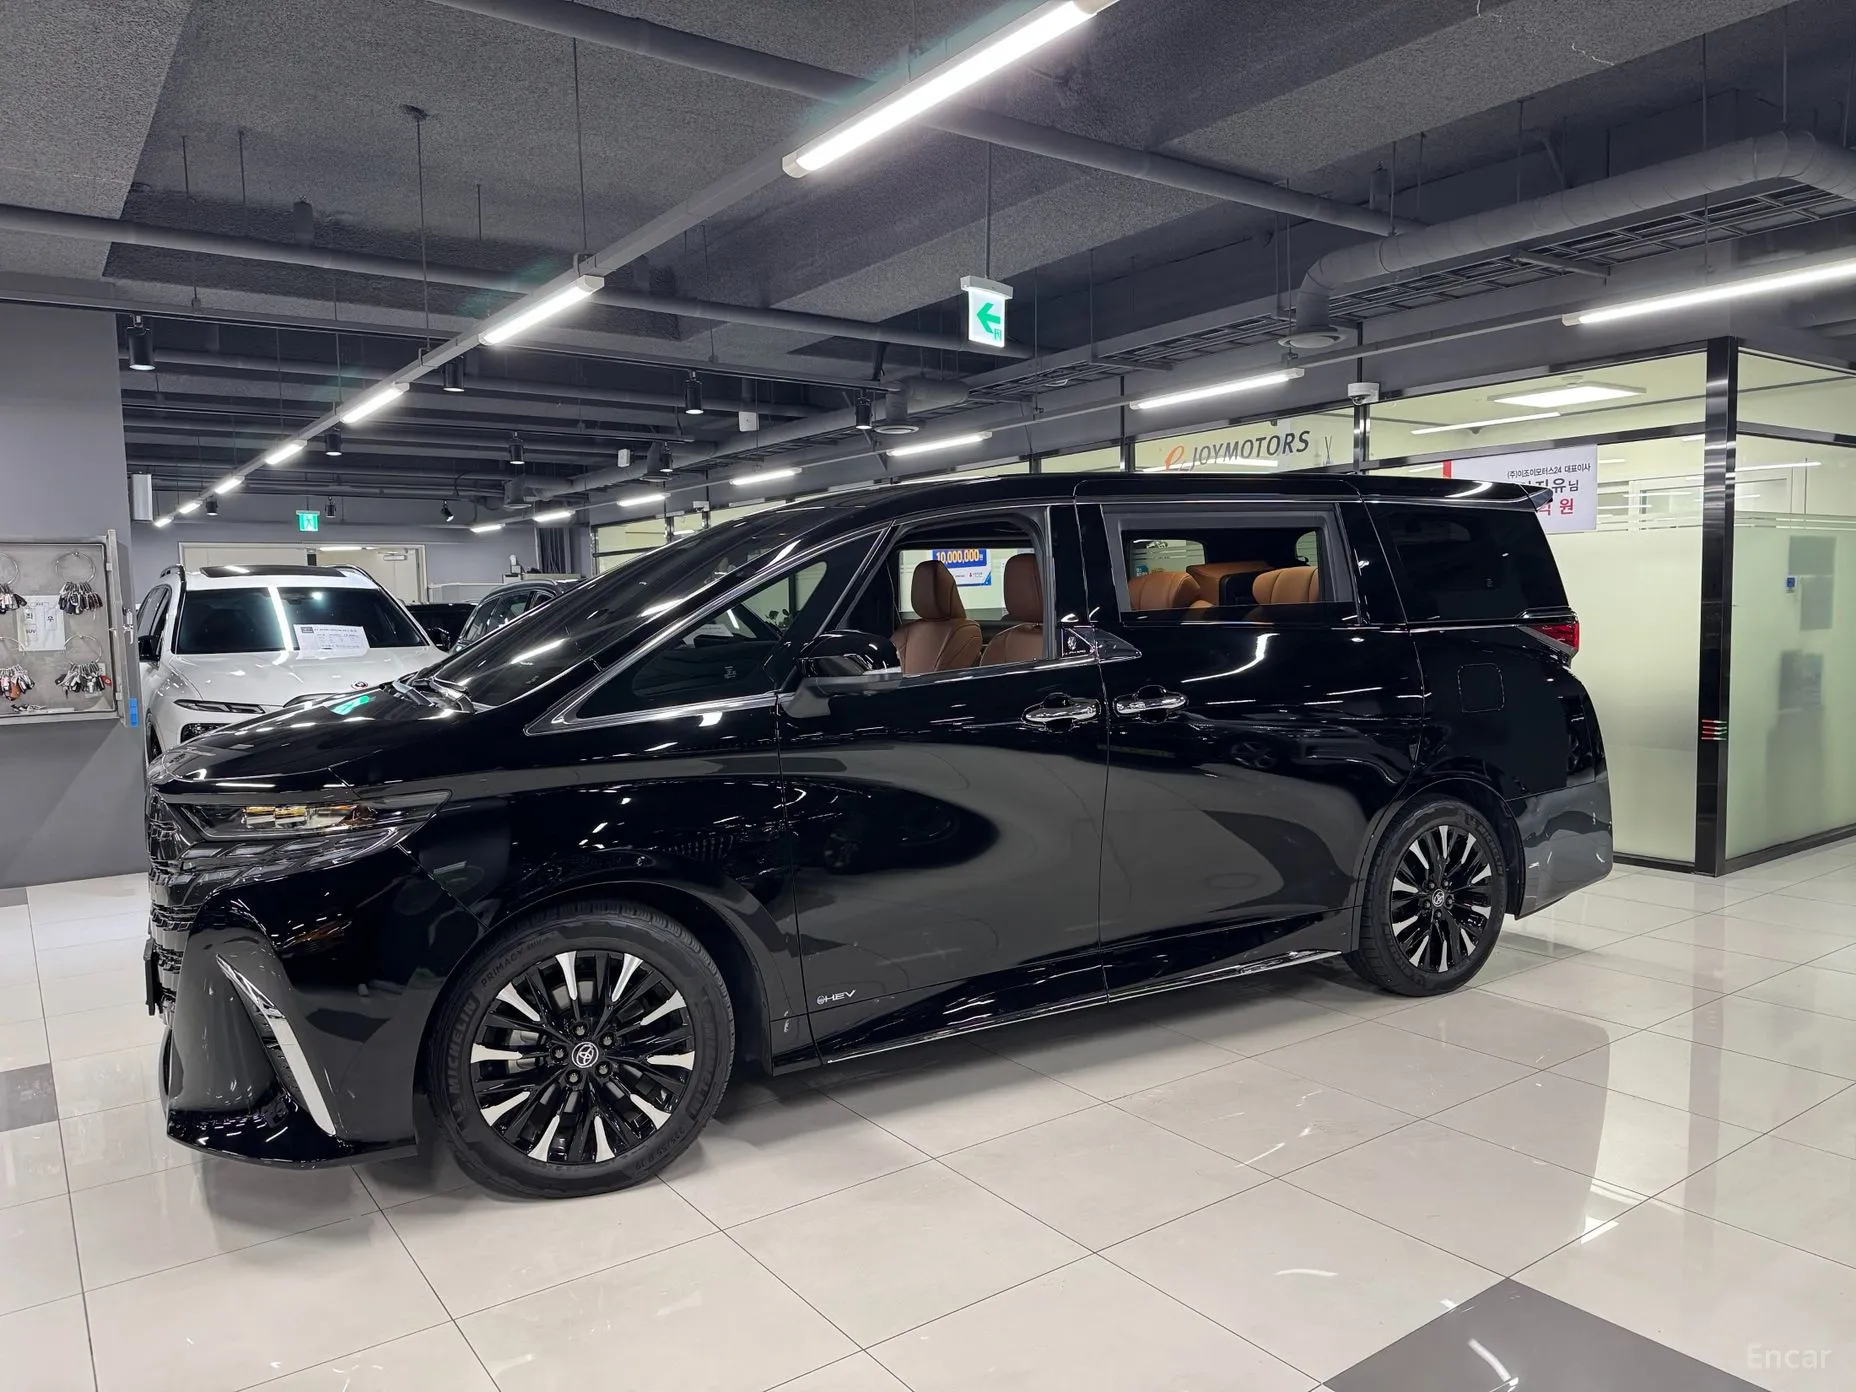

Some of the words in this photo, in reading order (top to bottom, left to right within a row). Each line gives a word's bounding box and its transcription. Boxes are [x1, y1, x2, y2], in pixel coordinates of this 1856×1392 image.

[1190, 430, 1311, 471] JOYMOTORS
[1564, 463, 1591, 474] 대표이사
[1559, 498, 1574, 515] 원
[448, 1000, 476, 1094] MICHELIN
